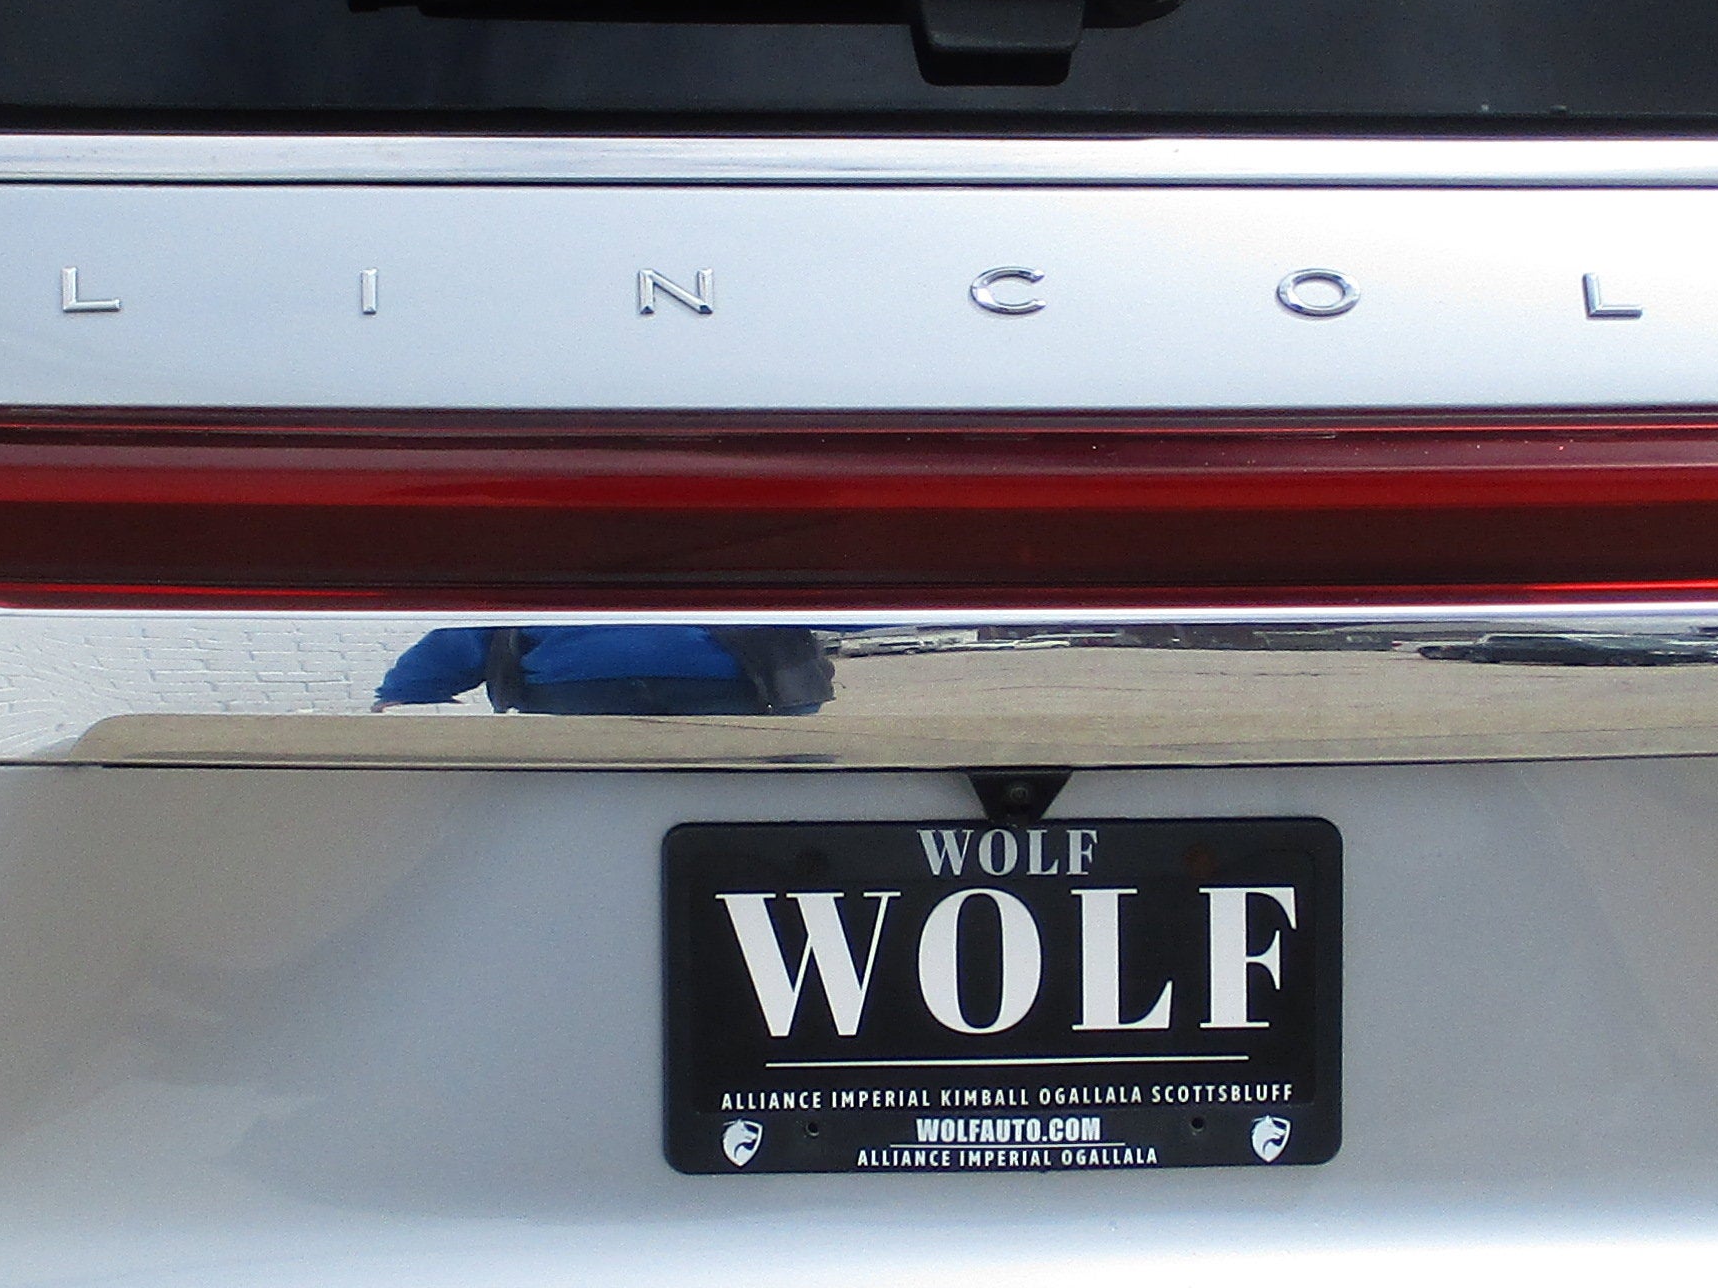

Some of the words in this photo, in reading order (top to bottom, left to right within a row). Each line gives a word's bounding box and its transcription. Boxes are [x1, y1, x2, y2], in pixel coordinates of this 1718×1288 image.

[917, 828, 1098, 876] WOLF
[715, 886, 1297, 1037] WOLF
[721, 1091, 822, 1110] ALLIANCE
[832, 1089, 931, 1108] IMPERIAL
[940, 1088, 1029, 1107] KIMBALL
[1039, 1086, 1142, 1105] OGALLALA
[1151, 1083, 1293, 1103] SCOTTSBLUFF
[916, 1117, 1101, 1143] WOLFAUTO.COM
[857, 1149, 951, 1167] ALLIANCE
[959, 1148, 1052, 1167] IMPERIAL
[1061, 1147, 1158, 1166] OGALLALA
